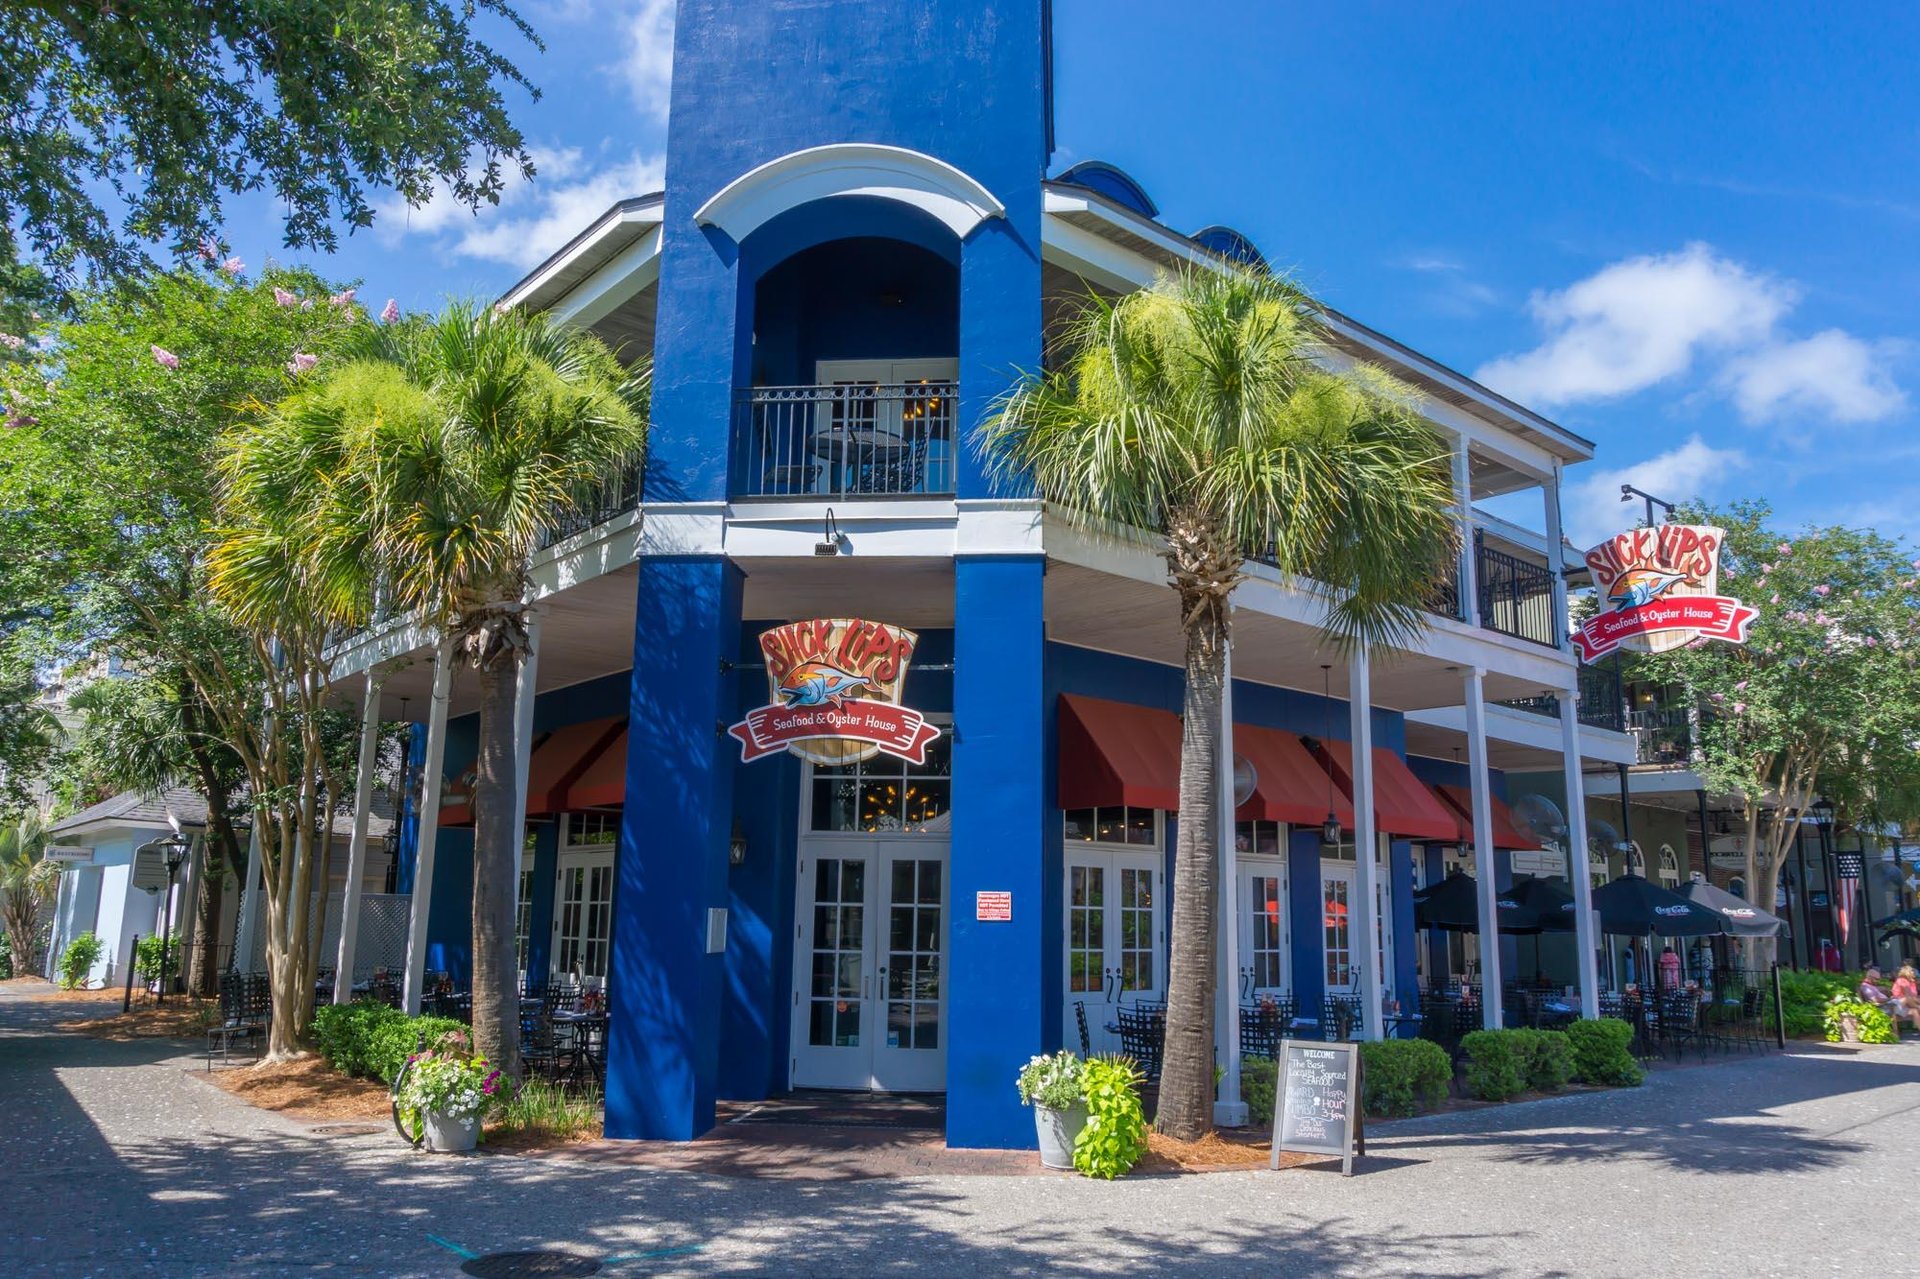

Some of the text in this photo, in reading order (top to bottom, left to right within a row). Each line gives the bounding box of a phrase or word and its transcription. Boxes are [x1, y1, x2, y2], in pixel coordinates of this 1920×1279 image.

[1603, 607, 1714, 634] Seafood & Oyster House
[773, 711, 897, 732] Seafood & Oyster House
[1303, 1049, 1336, 1059] WELCOME
[1290, 1058, 1326, 1069] The Best
[1322, 1086, 1346, 1101] Happy
